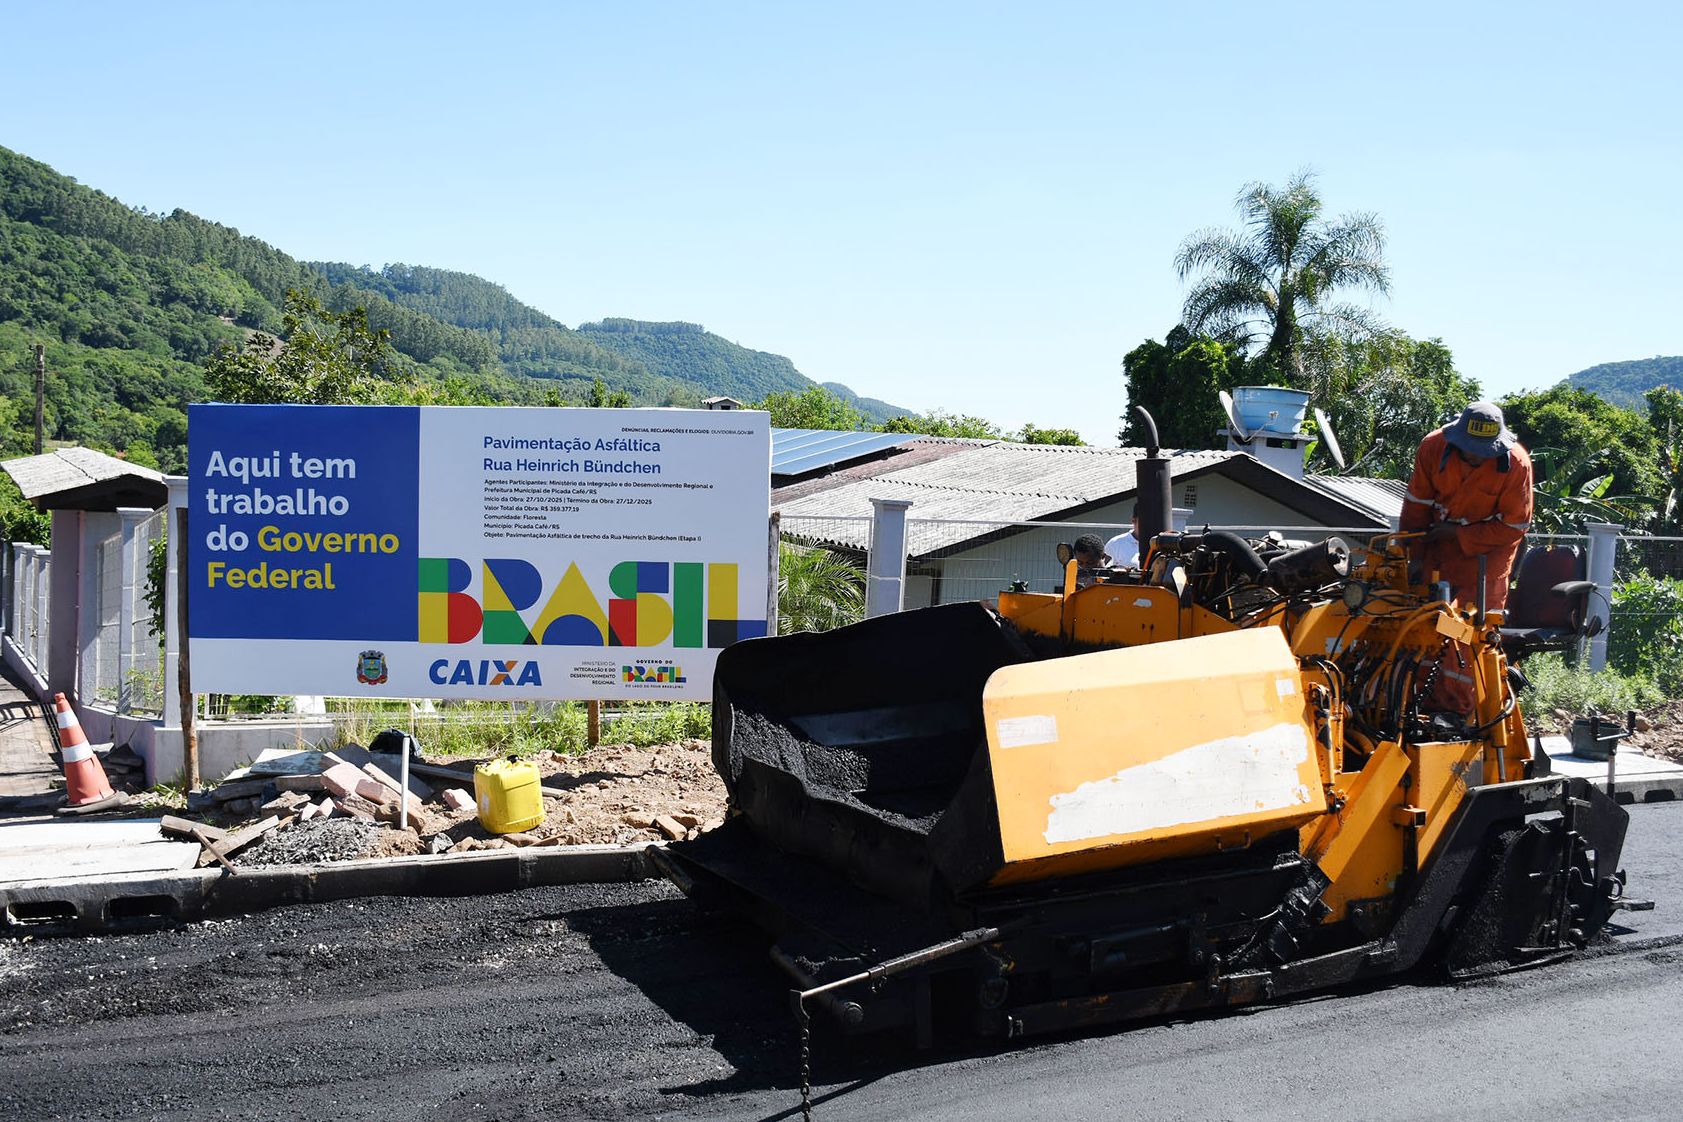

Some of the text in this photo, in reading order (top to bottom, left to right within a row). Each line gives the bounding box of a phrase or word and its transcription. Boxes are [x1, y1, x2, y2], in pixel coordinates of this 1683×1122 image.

[484, 436, 660, 453] Pavimentação Asfáltica
[205, 450, 356, 484] Aqui tem
[483, 459, 661, 474] Rua Heinrich Bündchen
[206, 488, 349, 515] trabalho
[206, 525, 399, 554] do Governo
[207, 562, 336, 590] Federal
[418, 558, 768, 648] BRASIL
[429, 659, 542, 686] CAIXA
[622, 666, 686, 683] BRASIL
